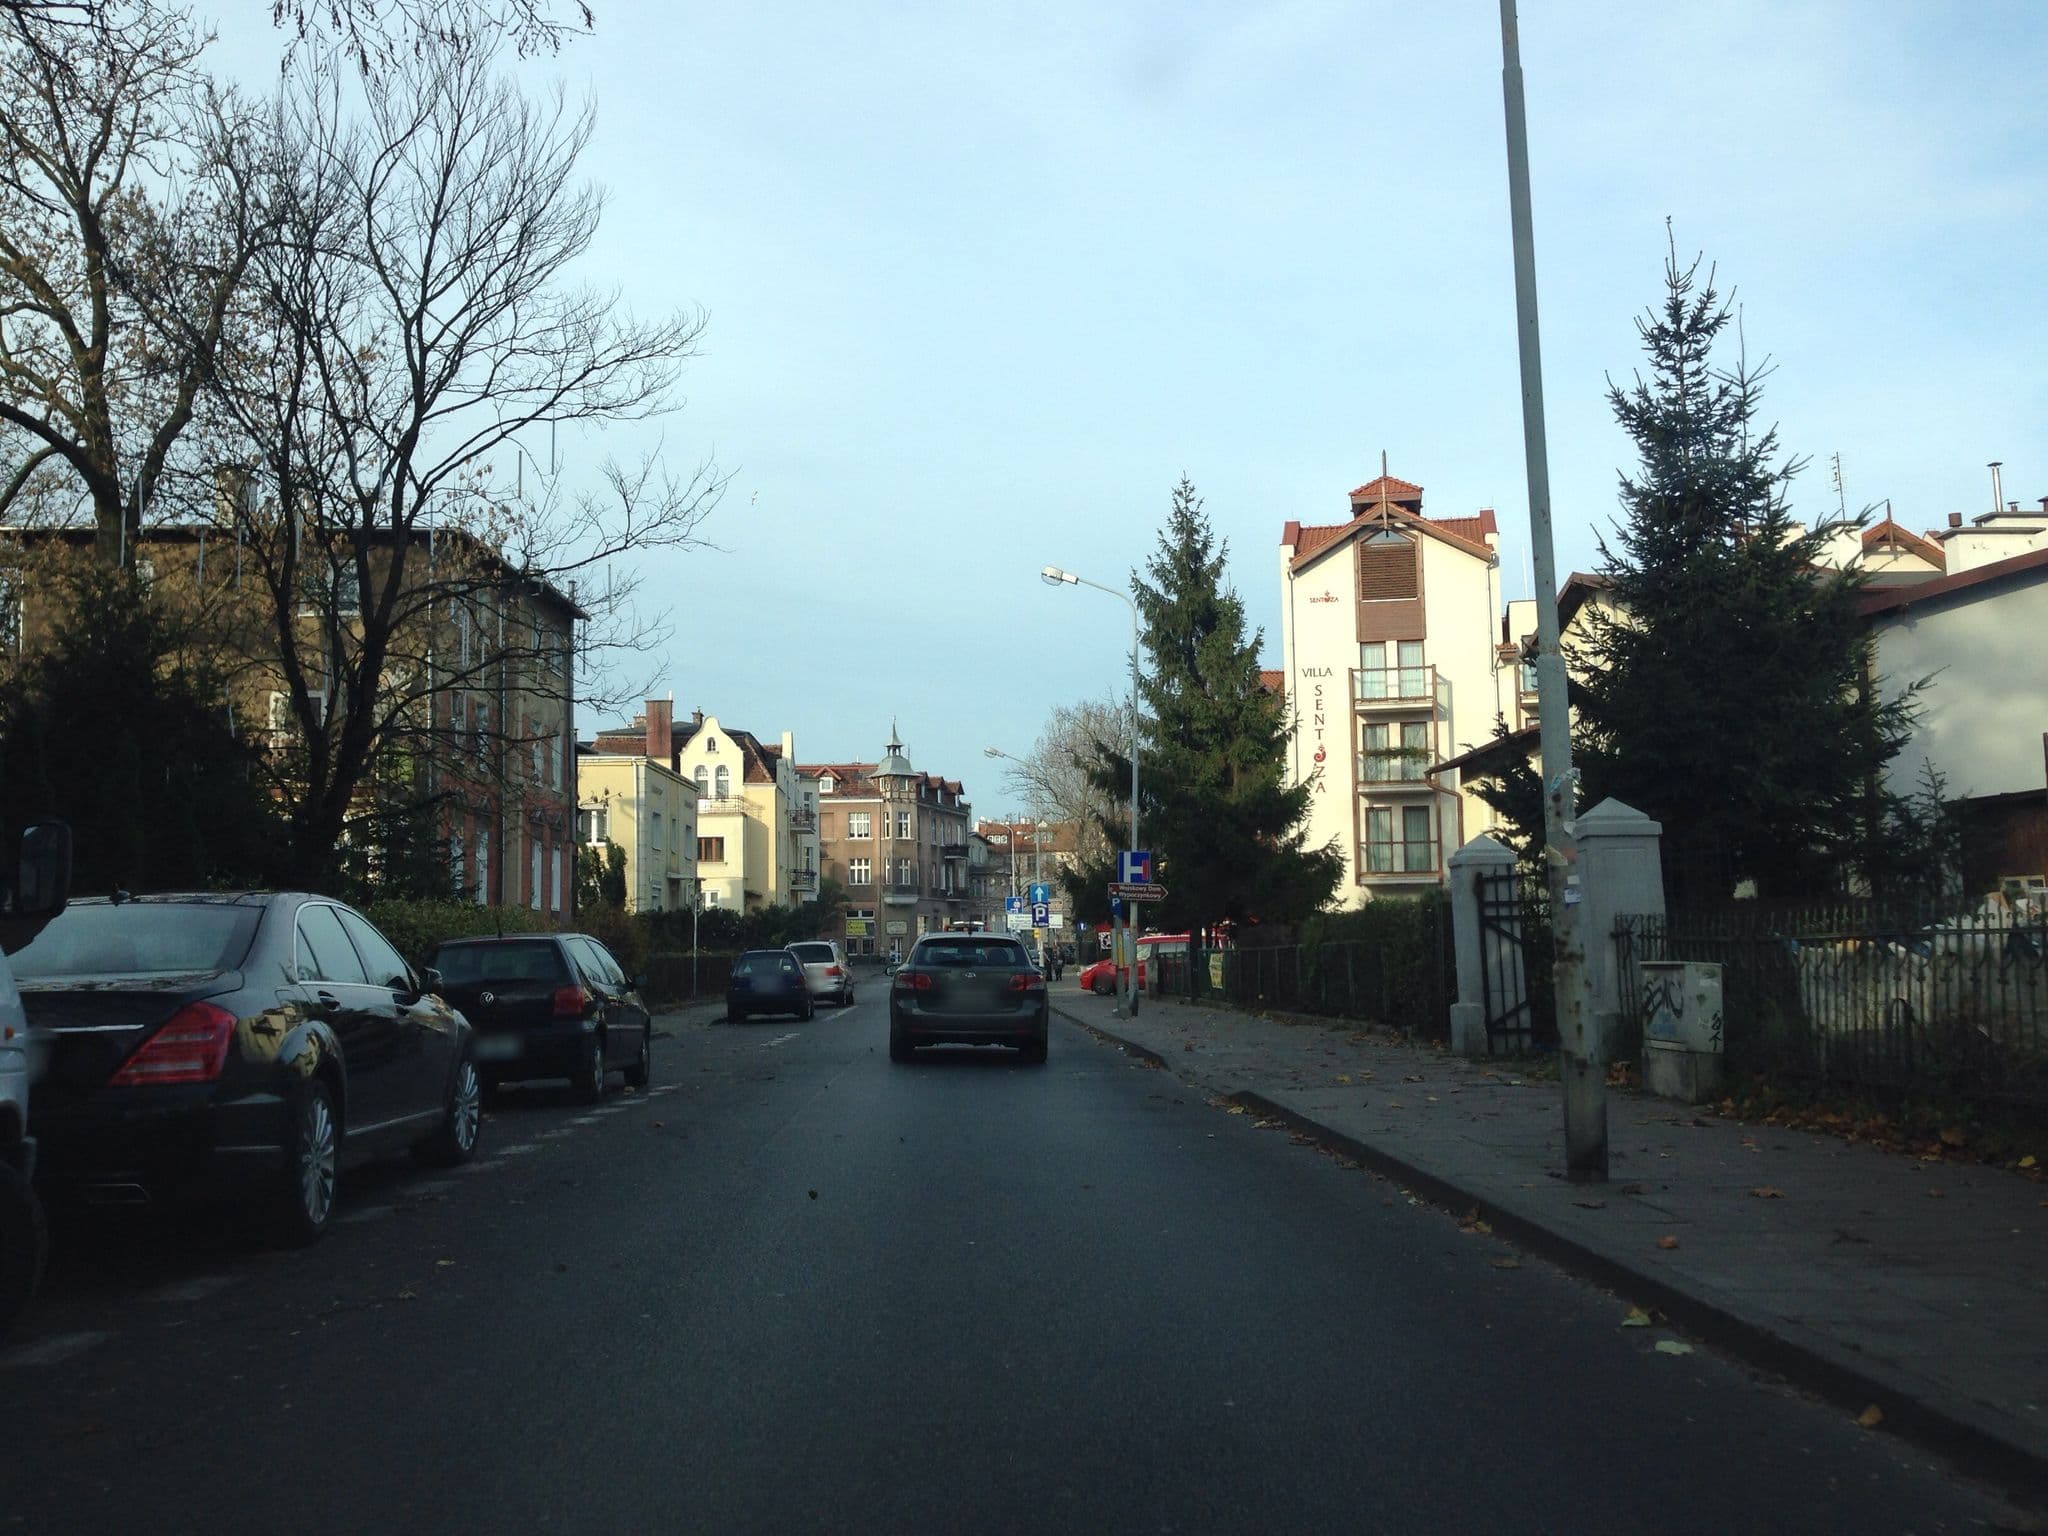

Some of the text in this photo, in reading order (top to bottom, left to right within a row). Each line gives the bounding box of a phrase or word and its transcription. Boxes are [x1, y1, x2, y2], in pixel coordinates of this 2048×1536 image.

[1302, 667, 1333, 678] VILLA
[1112, 898, 1121, 907] P
[1035, 907, 1046, 921] P
